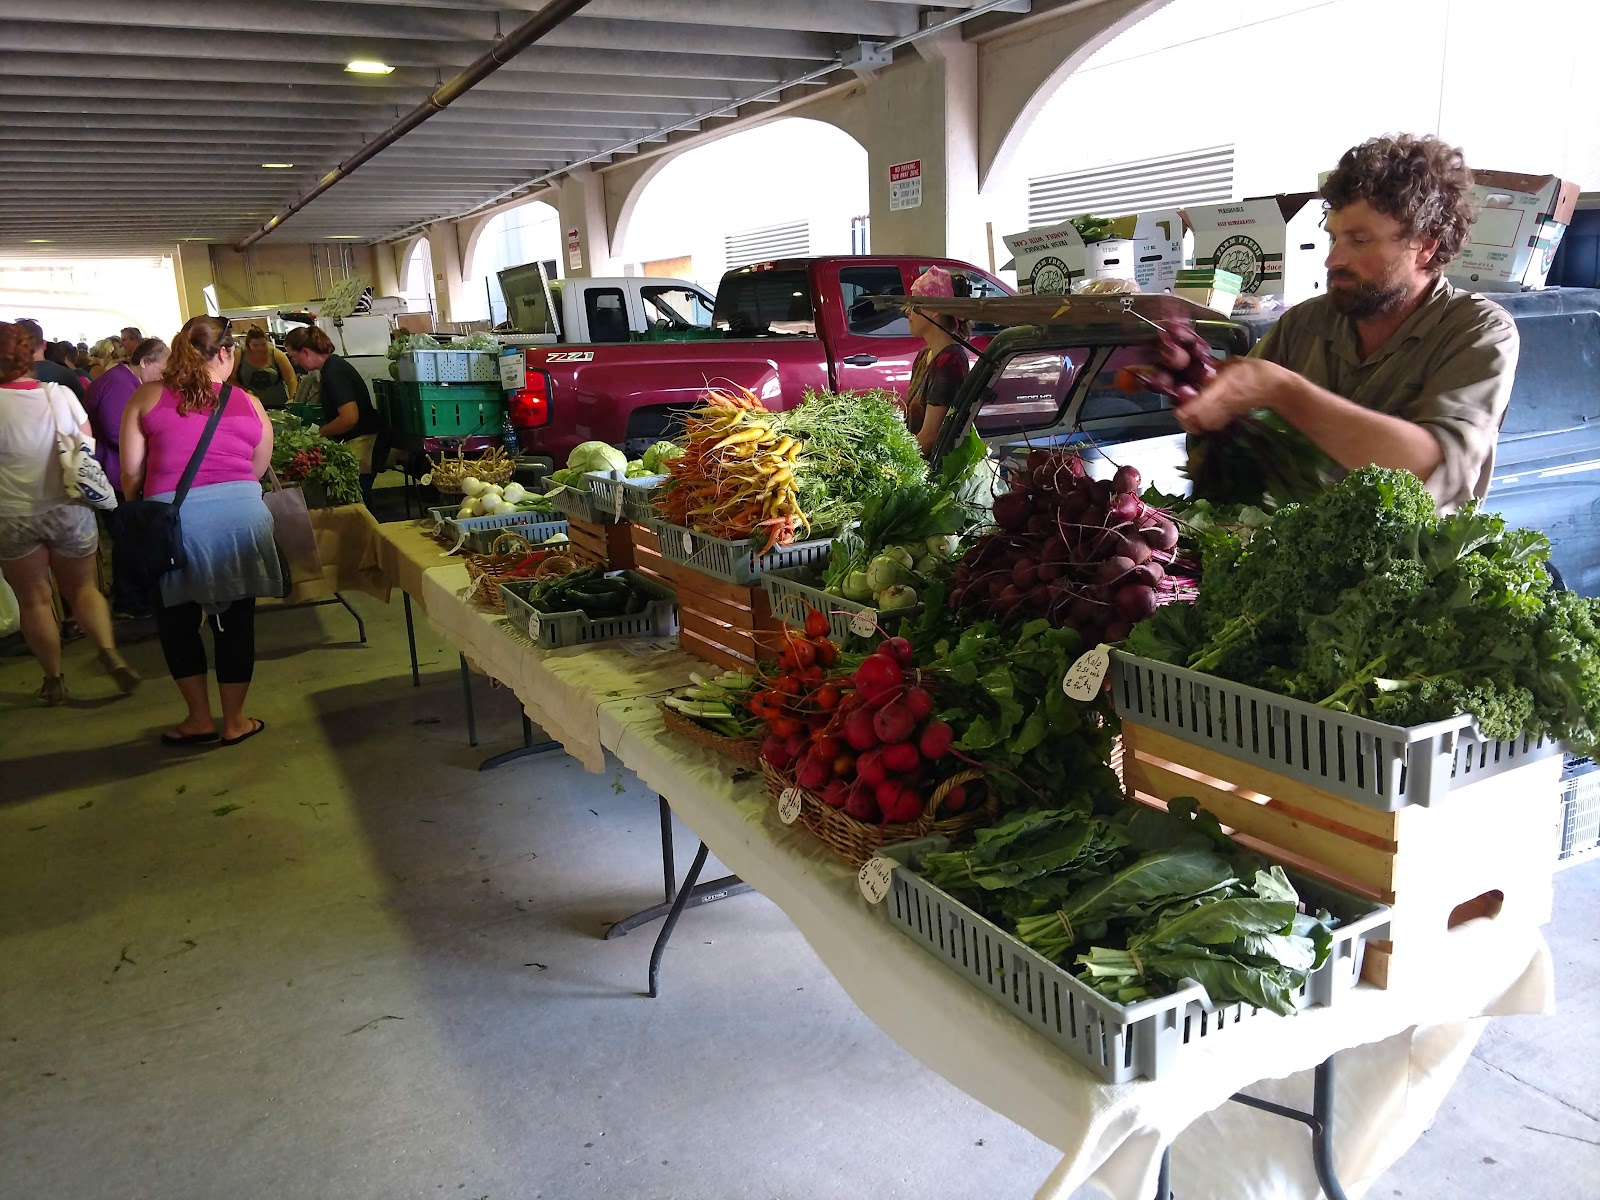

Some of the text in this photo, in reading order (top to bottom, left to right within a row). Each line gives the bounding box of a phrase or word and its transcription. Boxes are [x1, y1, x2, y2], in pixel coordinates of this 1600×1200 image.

[901, 163, 916, 172] PARKING
[1012, 230, 1069, 248] HANDLE WITH CARE
[1023, 239, 1068, 253] FRESH PRODUCE
[1216, 237, 1261, 256] FARM FRESH
[1032, 258, 1068, 277] FARM FRESH
[545, 351, 595, 363] Z71
[1085, 653, 1102, 670] Kale
[1066, 678, 1072, 687] 2
